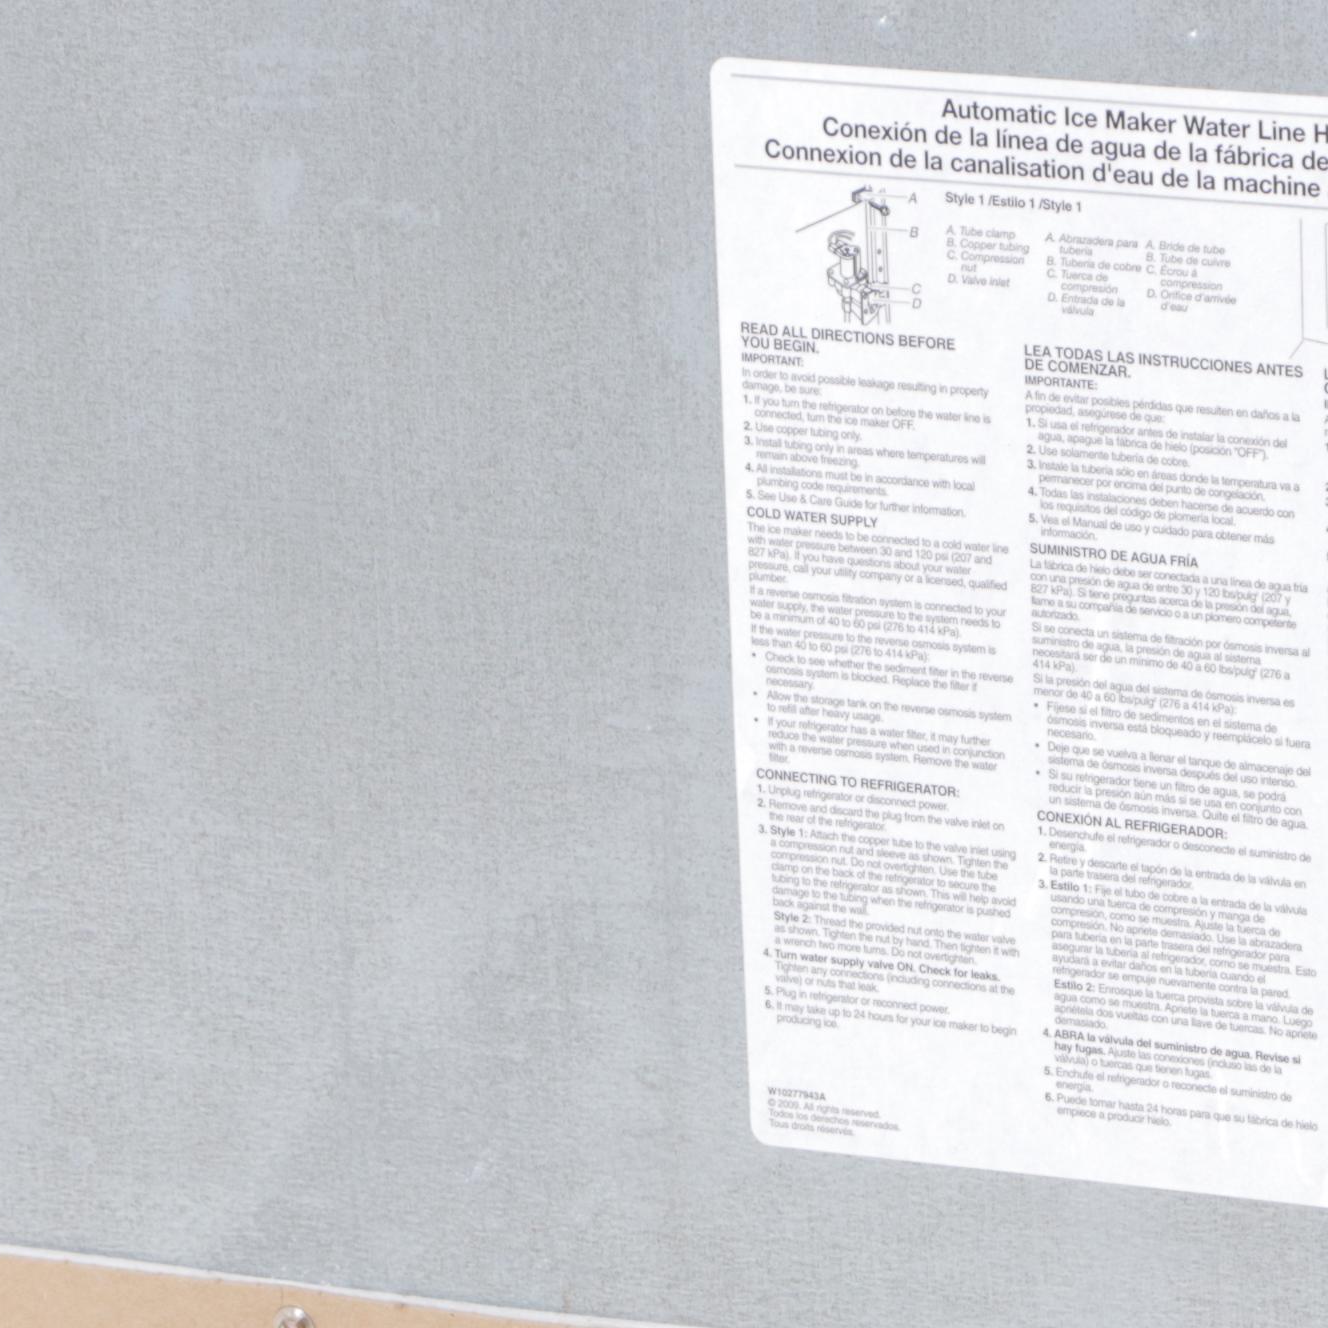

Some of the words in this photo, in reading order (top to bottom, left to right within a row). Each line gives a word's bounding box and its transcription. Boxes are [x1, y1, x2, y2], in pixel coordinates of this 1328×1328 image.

[941, 98, 1057, 126] Automatic
[1064, 106, 1098, 128] Ice
[1105, 109, 1177, 134] Maker
[1183, 114, 1251, 139] Water
[1258, 119, 1306, 143] Line
[822, 116, 927, 143] Conexión
[934, 124, 962, 146] de
[970, 126, 989, 148] la
[996, 128, 1048, 152] línea
[1055, 133, 1083, 154] de
[1090, 140, 1146, 162] agua
[1153, 140, 1182, 161] de
[1189, 142, 1208, 163] la
[1214, 144, 1294, 169] fábrica
[764, 138, 882, 167] Connexion
[889, 148, 917, 169] de
[924, 150, 943, 171] la
[950, 155, 1085, 181] canalisation
[1092, 162, 1154, 186] d'eau
[1161, 167, 1189, 189] de
[1197, 169, 1216, 191] la
[1223, 174, 1321, 198] machine
[908, 192, 917, 204] A
[945, 191, 975, 207] Style
[978, 194, 984, 206] 1
[1029, 197, 1035, 209] 1
[1076, 201, 1082, 213] 1
[909, 226, 919, 238] B
[911, 283, 922, 294] C
[912, 297, 922, 309] D
[740, 321, 779, 336] READ
[781, 325, 808, 339] ALL
[811, 327, 895, 346] DIRECTIONS
[898, 334, 956, 351] BEFORE
[741, 335, 770, 350] YOU
[773, 338, 819, 354] BEGIN.
[741, 352, 804, 367] IMPORTANT:
[1024, 344, 1052, 358] LEA
[1054, 346, 1103, 362] TODAS
[1107, 350, 1135, 365] LAS
[1138, 353, 1253, 374] INSTRUCCIONES
[1256, 362, 1304, 378] ANTES
[1024, 357, 1044, 371] DE
[1047, 359, 1131, 378] COMENZAR.
[1024, 375, 1097, 390] IMPORTANTE:
[746, 506, 782, 520] COLD
[783, 509, 827, 524] WATER
[830, 513, 878, 528] SUPPLY
[1030, 542, 1107, 560] SUMINISTRO
[1110, 549, 1128, 562] DE
[1130, 551, 1167, 565] AGUA
[1170, 553, 1199, 568] FRÍA
[756, 767, 838, 786] CONNECTING
[840, 775, 857, 788] TO
[860, 777, 960, 798] REFRIGERATOR:
[1036, 809, 1102, 827] CONEXIÓN
[1104, 816, 1122, 829] AL
[1124, 818, 1227, 840] REFRIGERADOR:
[763, 947, 772, 957] 4.
[774, 948, 798, 961] Turn
[799, 953, 828, 964] water
[830, 956, 865, 970] supply
[867, 960, 895, 971] valve
[896, 961, 916, 973] ON.
[918, 963, 951, 976] Check
[953, 967, 968, 978] for
[970, 968, 1001, 982] leaks.
